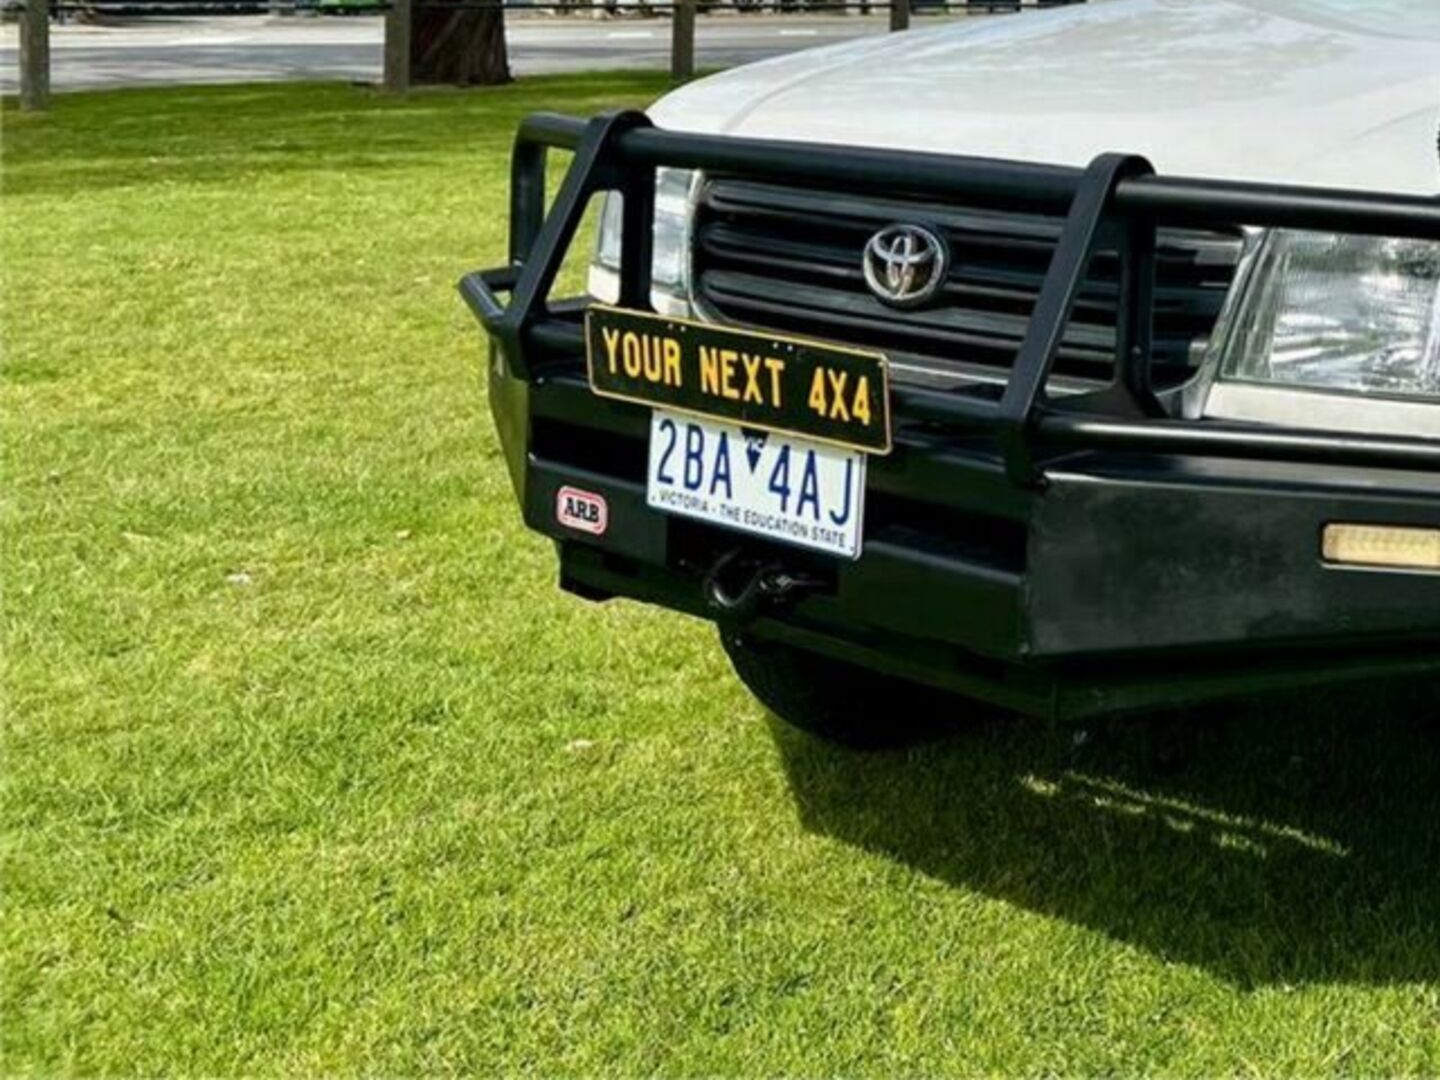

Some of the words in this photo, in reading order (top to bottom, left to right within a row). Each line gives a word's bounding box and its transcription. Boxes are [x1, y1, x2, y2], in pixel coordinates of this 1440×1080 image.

[602, 326, 682, 388] YOUR
[699, 346, 785, 408] NEXT
[808, 366, 872, 426] 4X4
[564, 496, 600, 523] ARB
[657, 418, 733, 500] 2BA
[768, 444, 854, 526] 4AJ
[659, 488, 709, 512] VICTORIA
[720, 503, 741, 522] THE
[743, 510, 808, 538] EDUCATION
[811, 525, 847, 549] STATE
